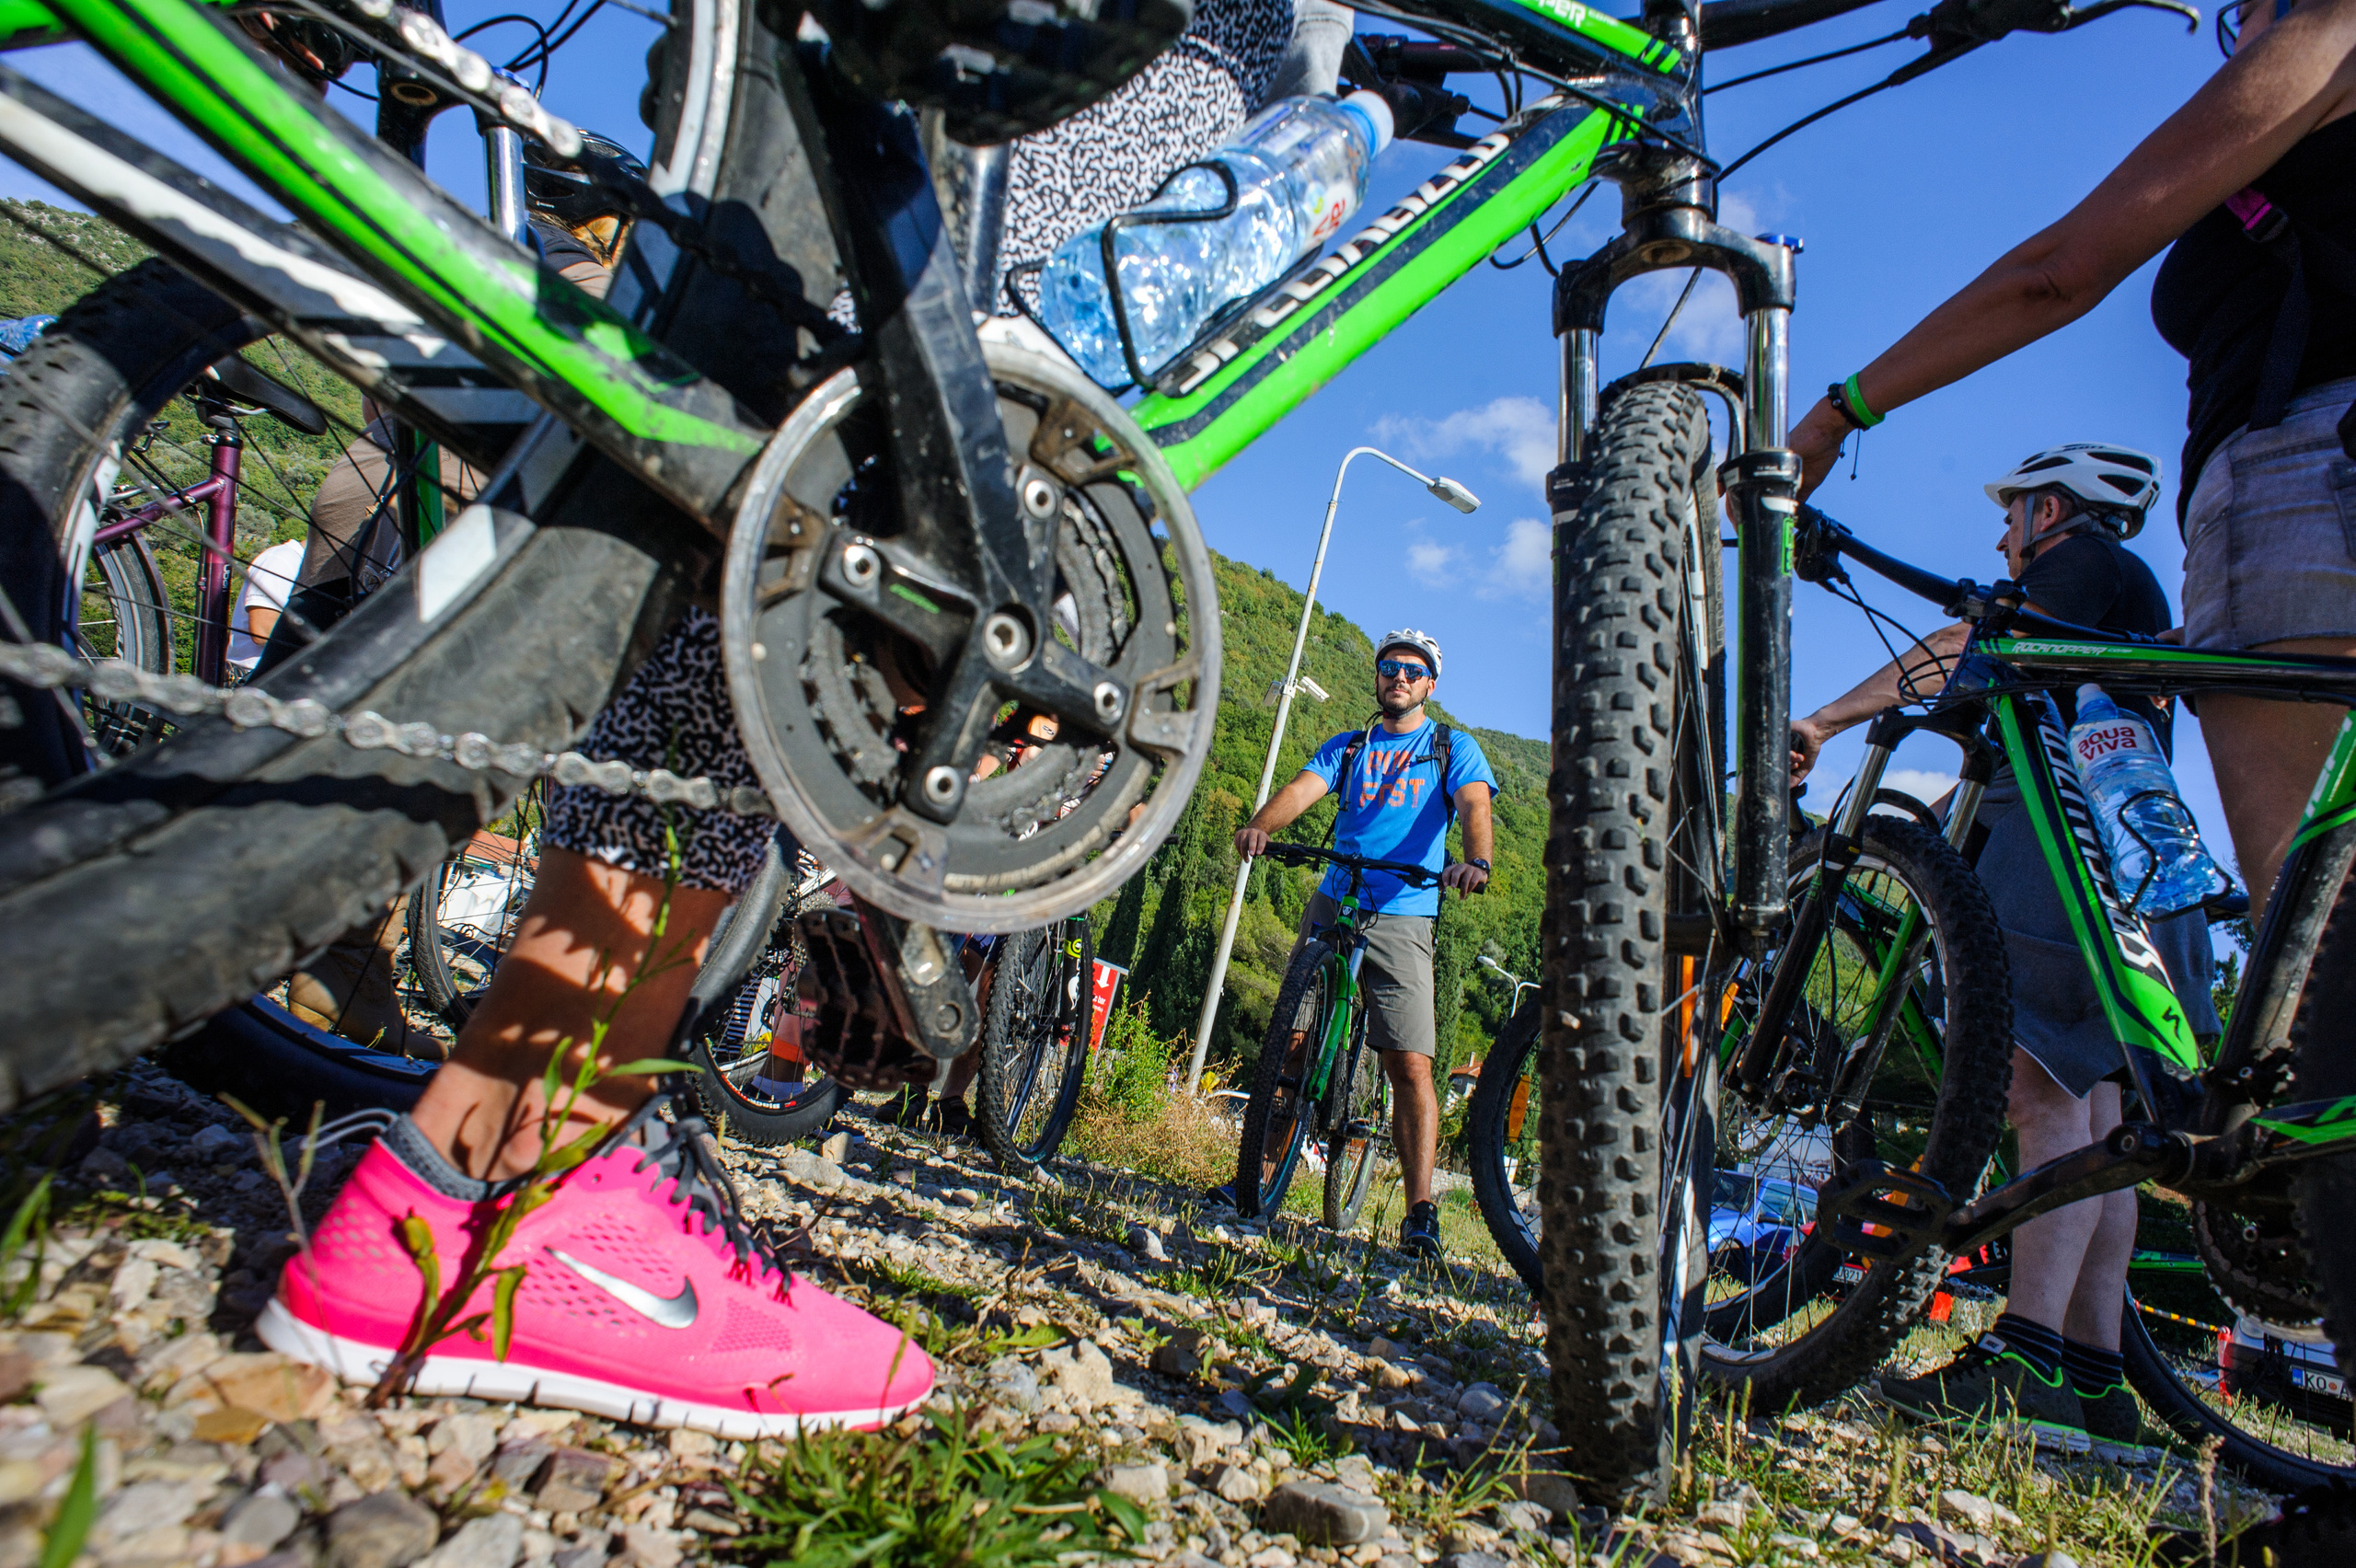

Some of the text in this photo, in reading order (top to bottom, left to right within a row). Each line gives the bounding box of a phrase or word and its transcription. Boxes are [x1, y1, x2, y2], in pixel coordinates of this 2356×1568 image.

[2078, 726, 2136, 754] aqua
[2083, 737, 2137, 761] viva
[2305, 1373, 2327, 1390] KO
